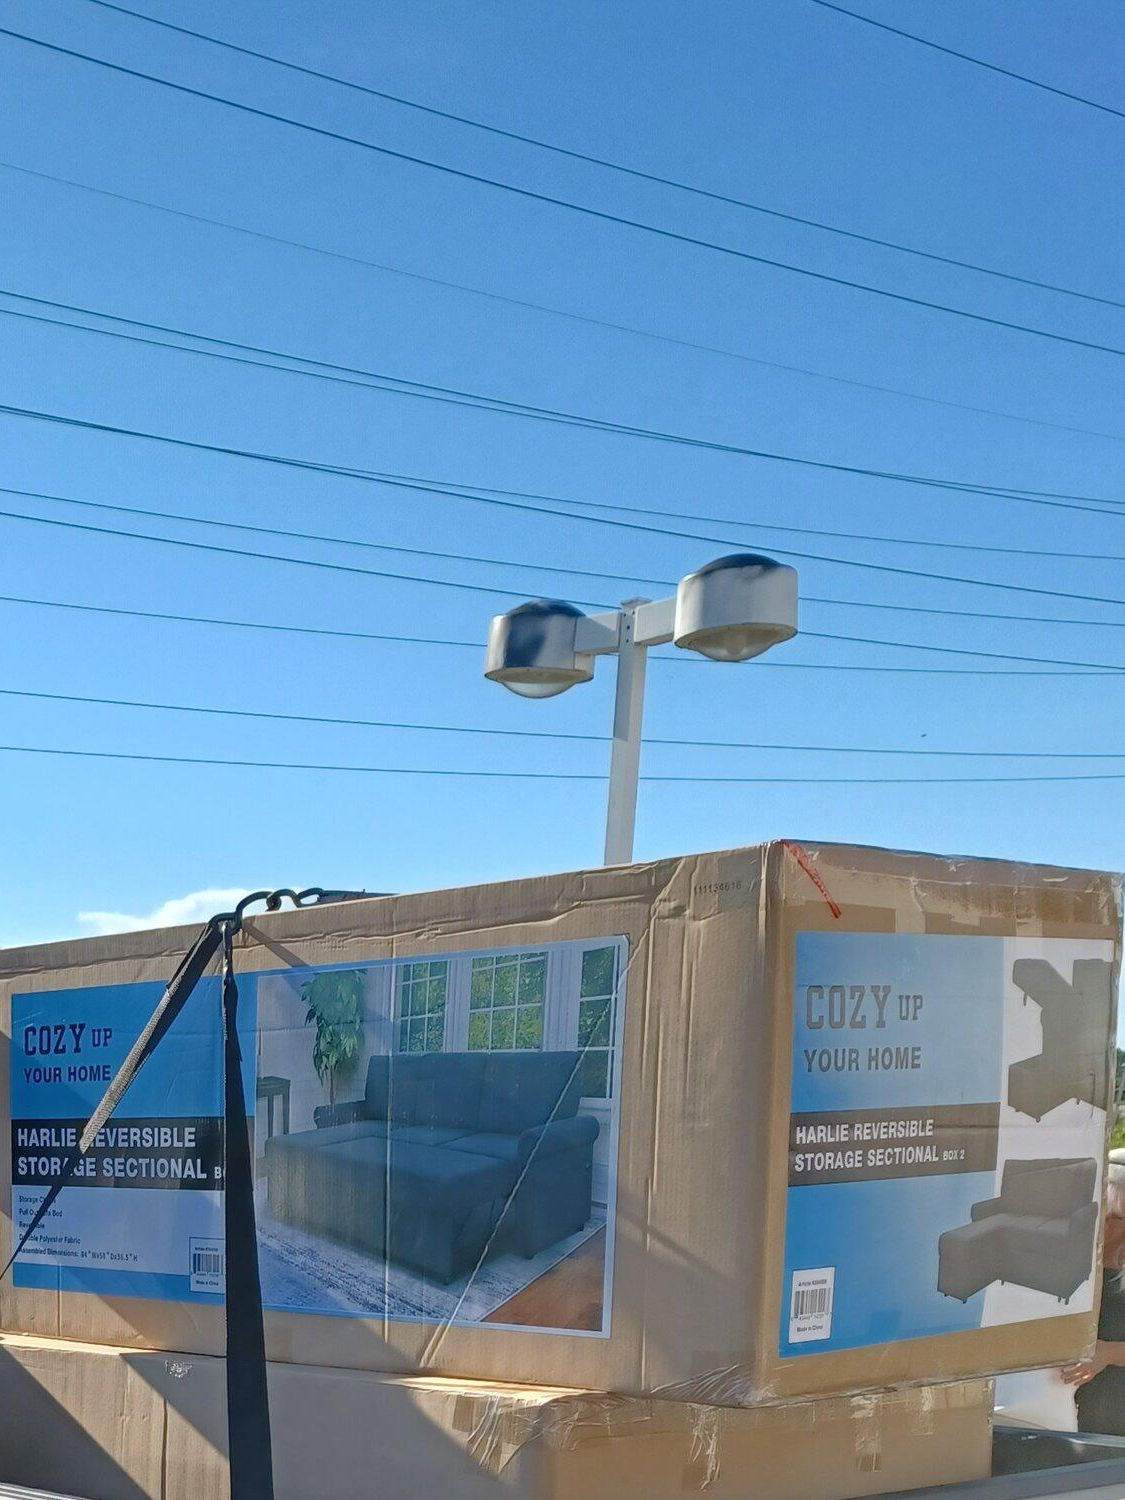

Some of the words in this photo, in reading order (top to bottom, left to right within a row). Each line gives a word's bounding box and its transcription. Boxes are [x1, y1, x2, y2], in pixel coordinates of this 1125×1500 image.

[806, 985, 891, 1029] COZY
[898, 995, 923, 1020] UP
[24, 1023, 86, 1056] COZY
[91, 1027, 113, 1048] UP
[804, 1048, 860, 1073] YOUR
[867, 1046, 922, 1070] HOME
[24, 1067, 62, 1084] YOUR
[67, 1065, 112, 1082] HOME
[18, 1128, 77, 1148] HARLIE
[89, 1127, 196, 1148] EVERSIBLE
[796, 1124, 849, 1144] HARLIE
[854, 1119, 934, 1140] REVERSIBLE
[102, 1158, 207, 1179] SECTIONAL
[794, 1150, 863, 1172] STORAGE
[867, 1145, 939, 1167] SECTIONAL
[942, 1150, 959, 1161] BOX
[959, 1149, 965, 1160] 2
